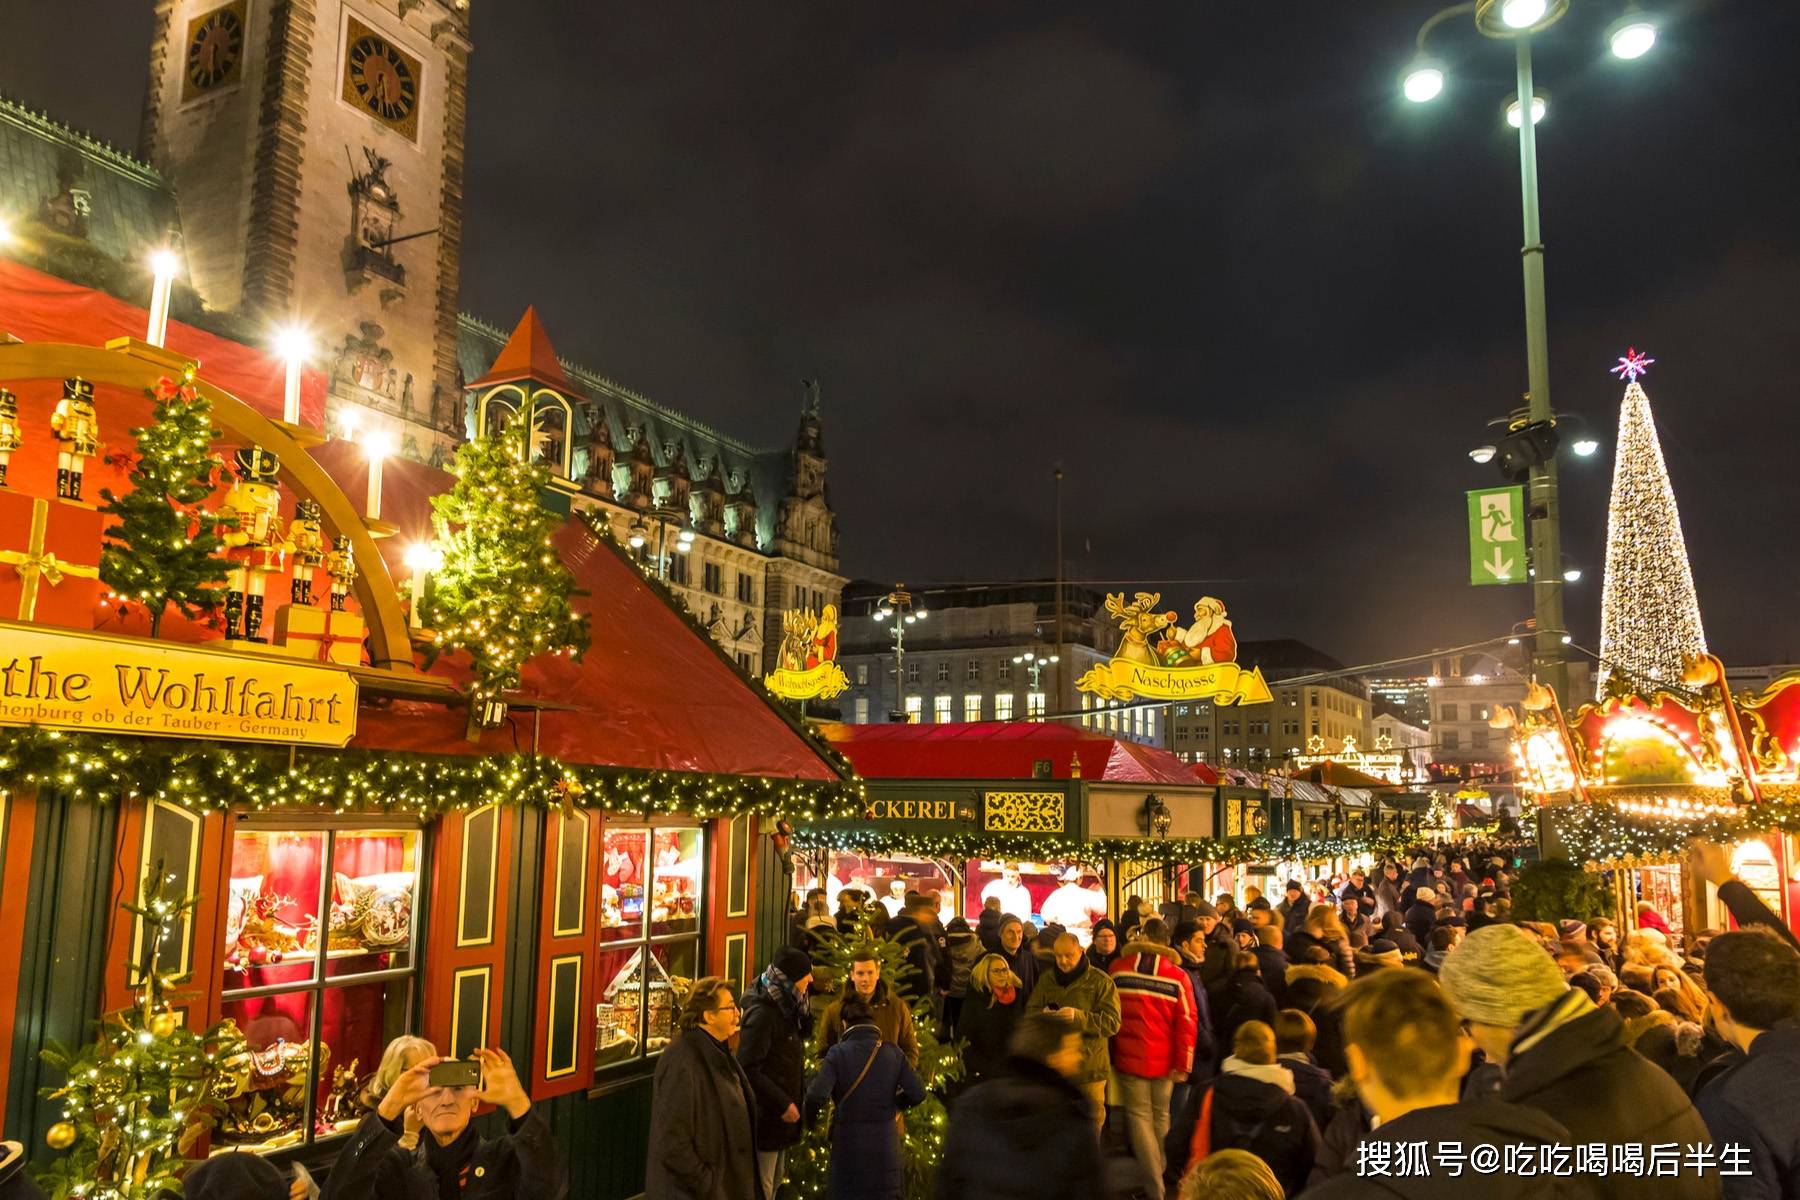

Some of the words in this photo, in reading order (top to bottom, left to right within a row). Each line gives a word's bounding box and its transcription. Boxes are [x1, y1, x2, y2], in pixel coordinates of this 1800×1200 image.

[2, 656, 91, 702] the
[115, 665, 342, 725] Wohlfahrt
[1131, 667, 1216, 694] Naschgasse
[92, 708, 114, 723] ob
[123, 712, 152, 727] der
[161, 713, 221, 731] Tauber
[239, 721, 309, 740] Germany
[866, 799, 956, 819] CKEREI
